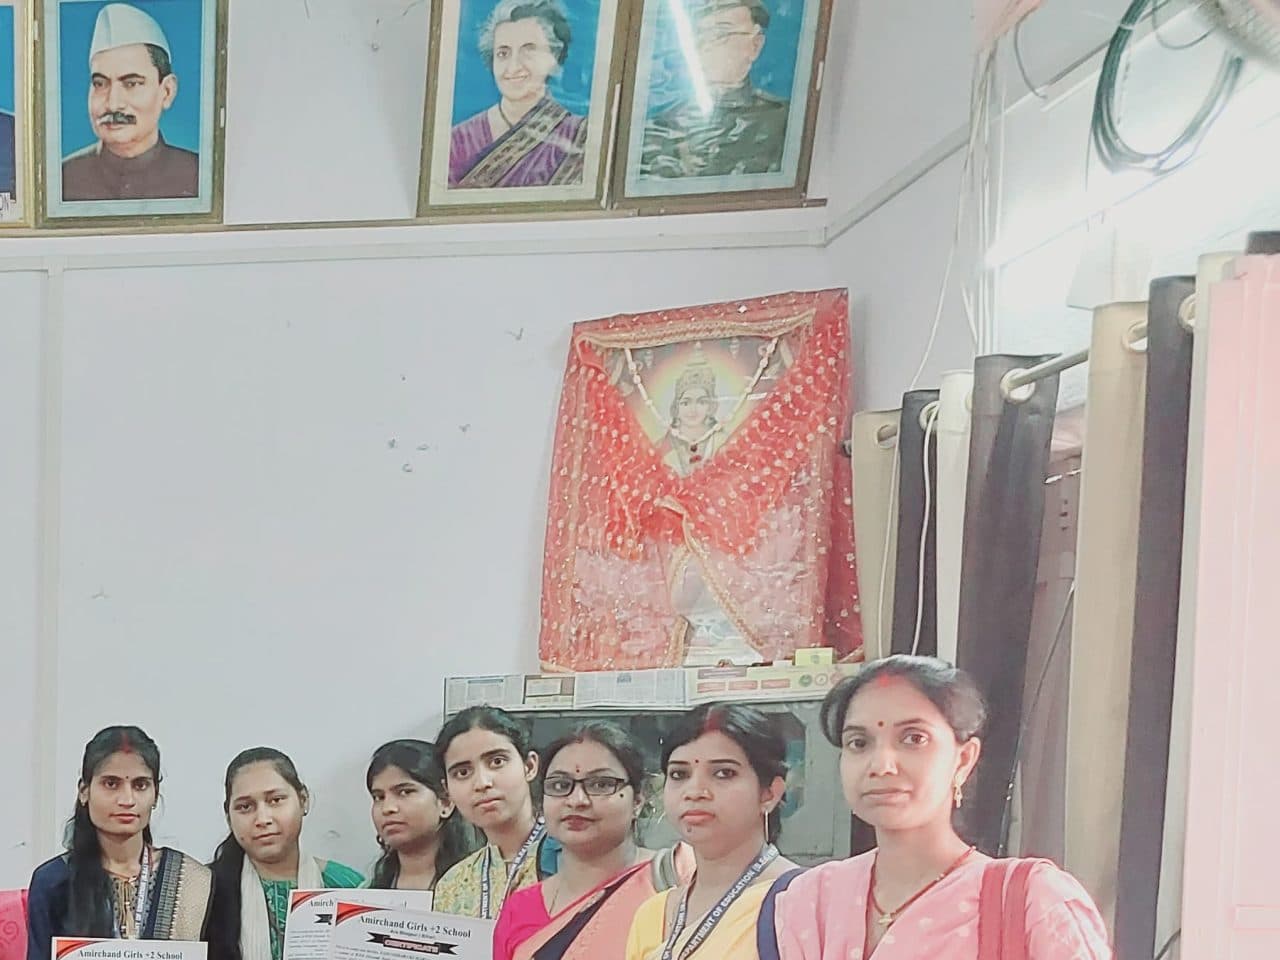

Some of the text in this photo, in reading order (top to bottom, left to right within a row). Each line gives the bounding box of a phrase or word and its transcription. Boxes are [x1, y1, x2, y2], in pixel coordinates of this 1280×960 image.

[713, 906, 723, 918] OF
[721, 875, 752, 908] EDUCATION
[359, 915, 405, 930] Amirchand
[406, 921, 428, 933] Girls
[442, 926, 471, 939] School
[79, 949, 121, 959] Amirchand
[123, 950, 143, 959] Girls
[157, 951, 183, 960] School
